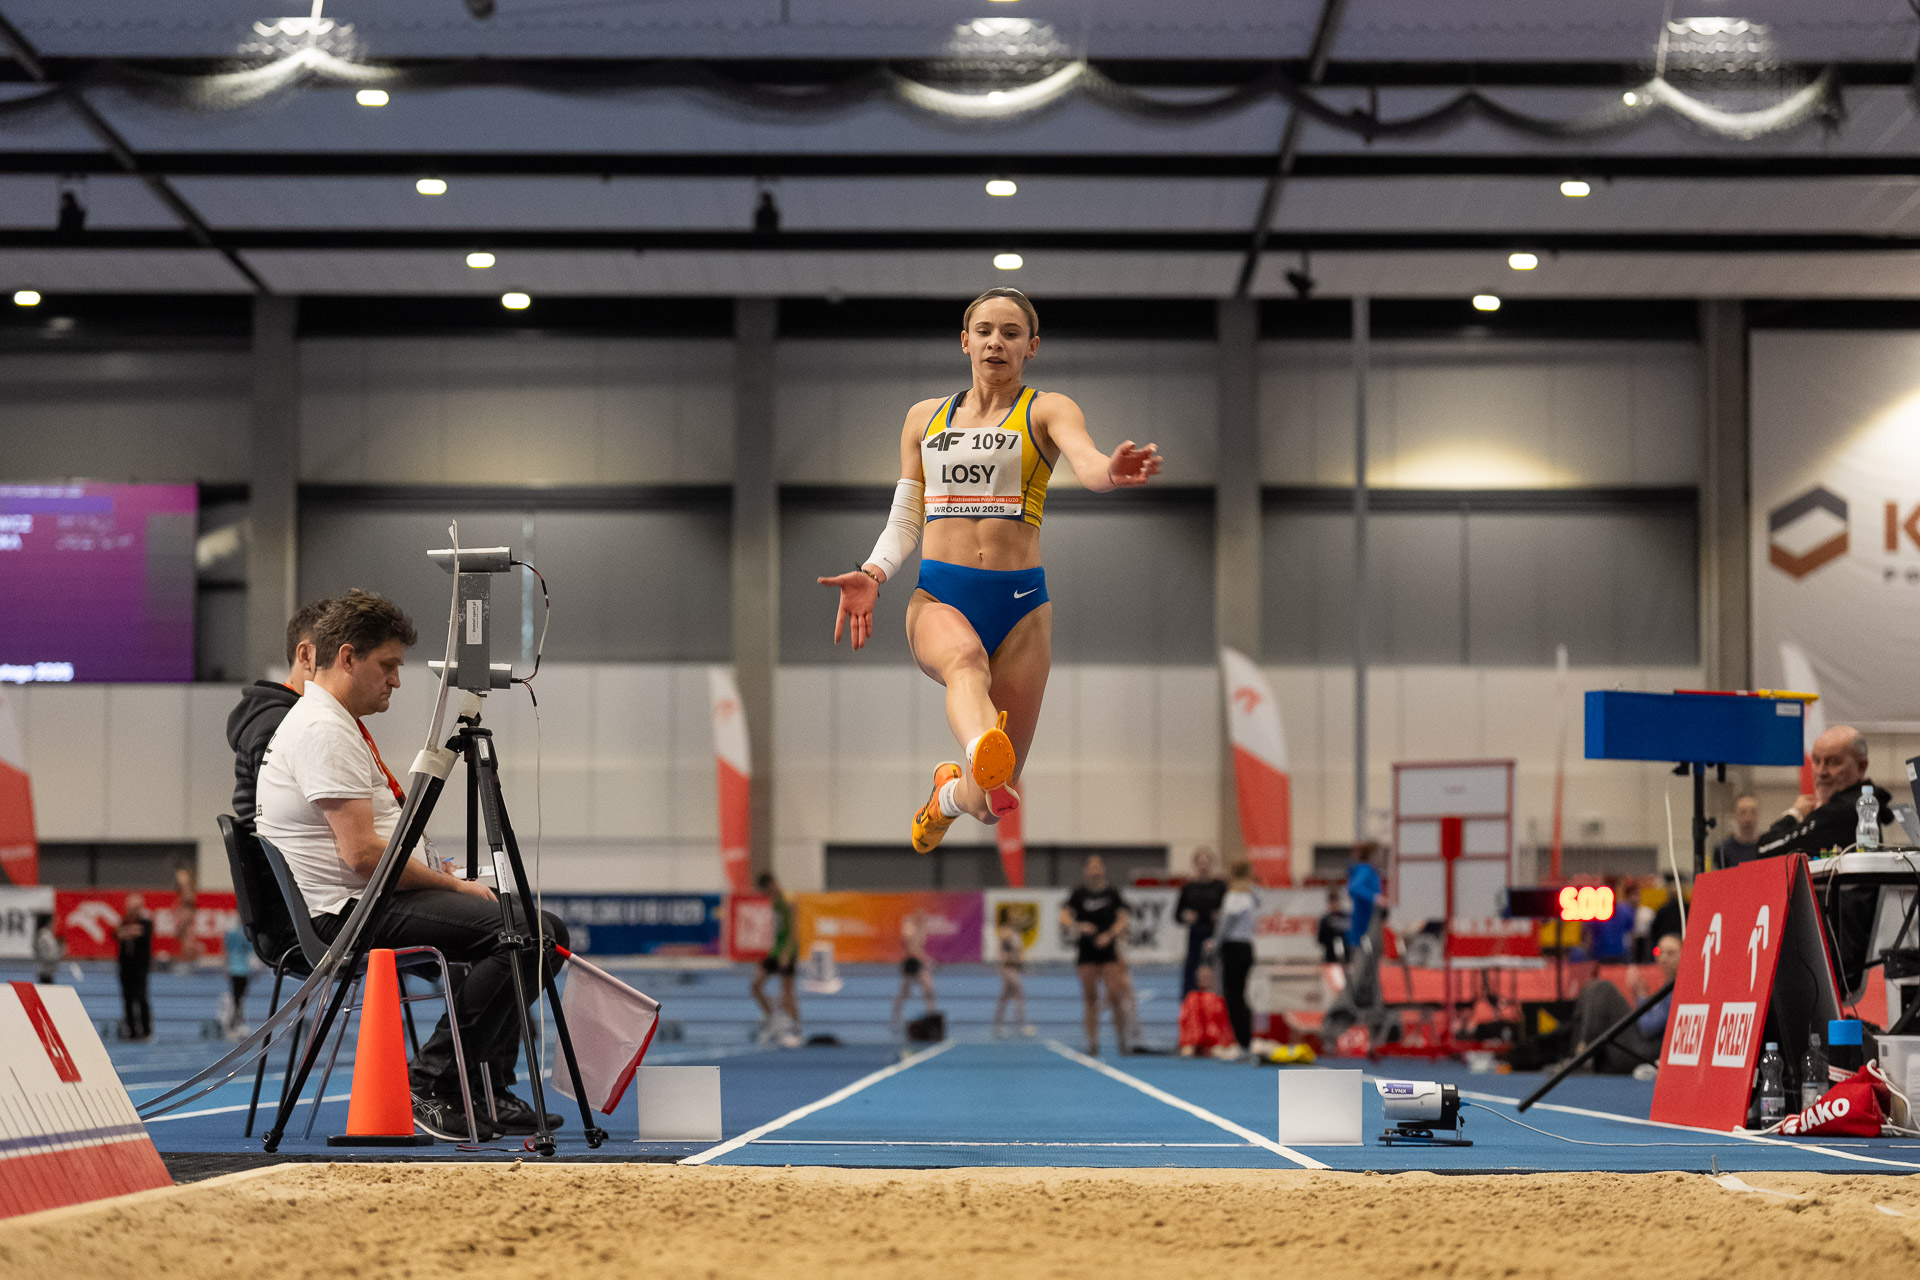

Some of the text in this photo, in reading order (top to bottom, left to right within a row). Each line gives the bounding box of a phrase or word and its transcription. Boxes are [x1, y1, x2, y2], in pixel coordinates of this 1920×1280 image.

[927, 432, 1018, 451] 4F 1097
[942, 464, 995, 483] LOSY
[933, 505, 1005, 513] WROCŁAW 2025
[1673, 1013, 1706, 1055] ORLEN
[1717, 1012, 1753, 1056] ORLEN
[1799, 1098, 1850, 1132] JAKO
